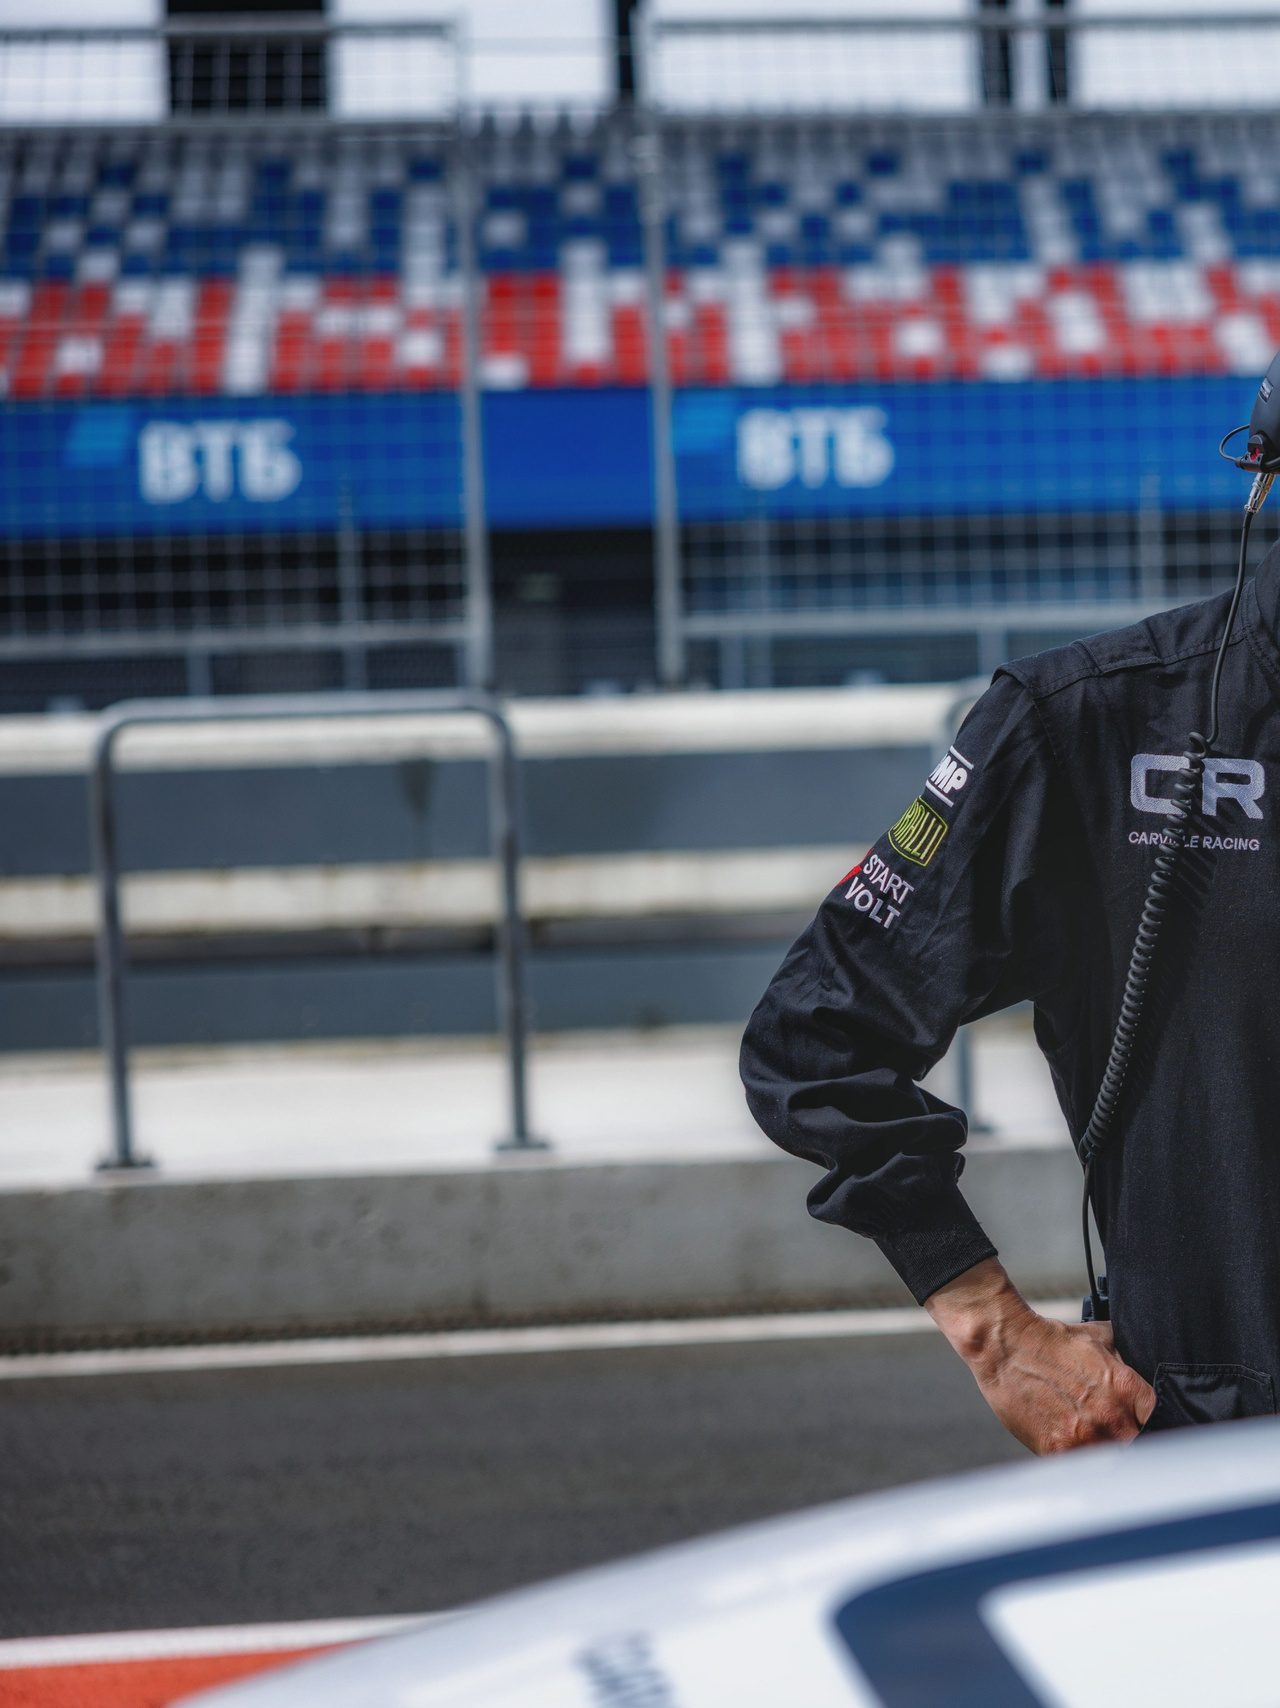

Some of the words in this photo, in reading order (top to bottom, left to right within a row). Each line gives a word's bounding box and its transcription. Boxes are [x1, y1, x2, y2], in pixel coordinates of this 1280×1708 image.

[137, 418, 302, 504] ВТБ
[735, 406, 895, 490] ВТБ
[929, 753, 968, 794] MP
[1130, 753, 1265, 819] CR
[893, 799, 943, 860] RIALLI
[1202, 836, 1260, 851] RACING
[844, 877, 901, 929] VOLT
[863, 854, 914, 904] START
